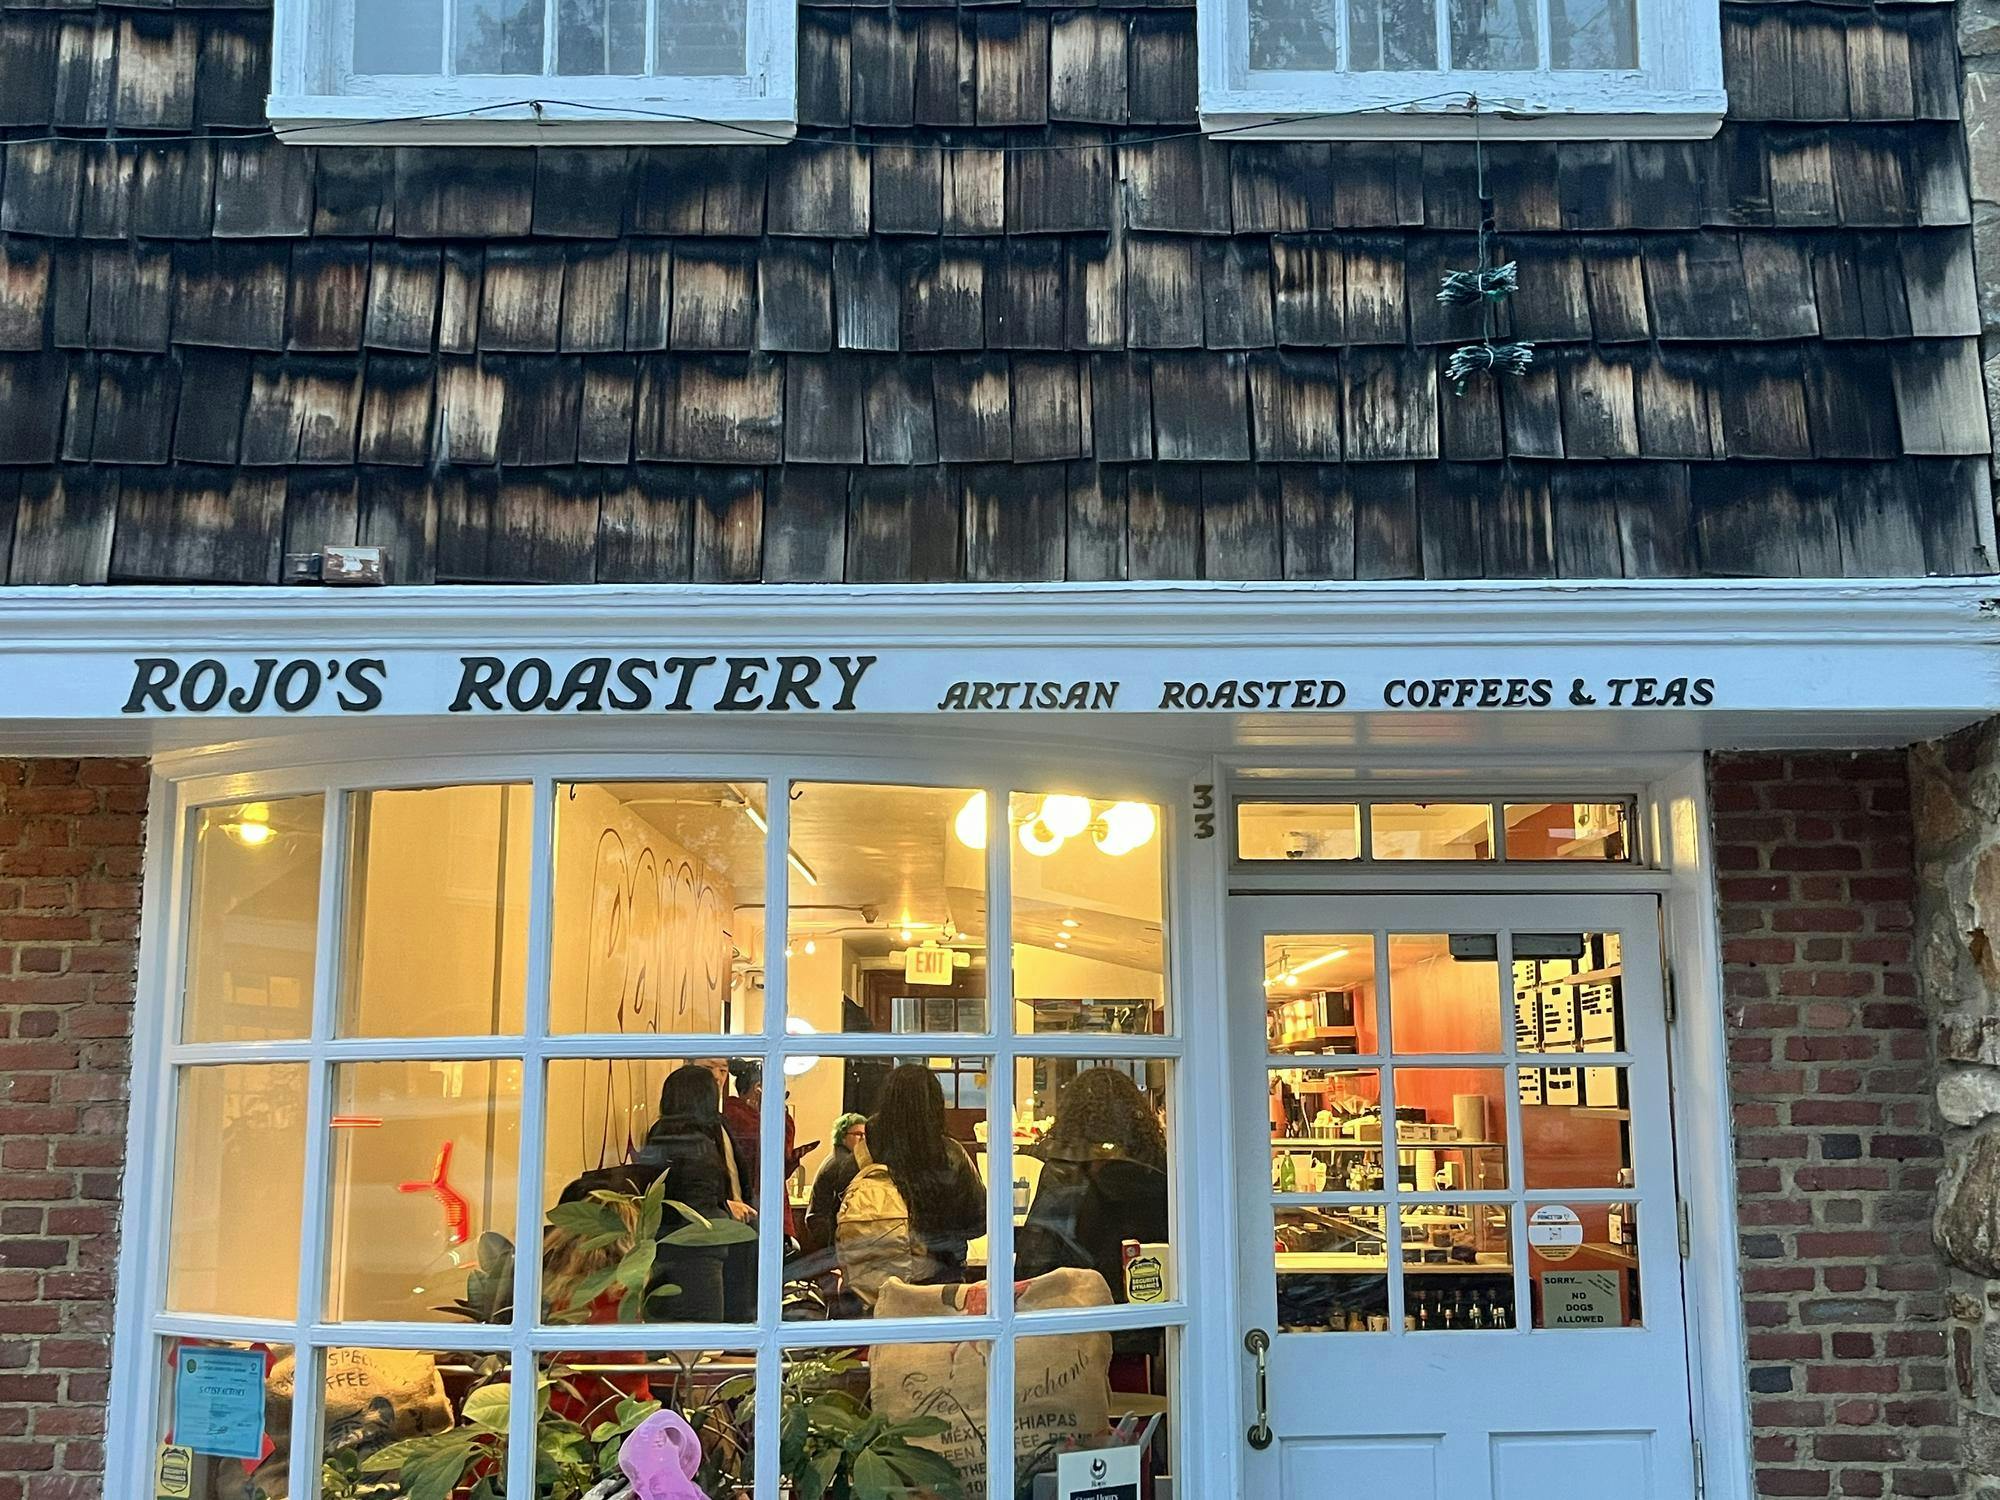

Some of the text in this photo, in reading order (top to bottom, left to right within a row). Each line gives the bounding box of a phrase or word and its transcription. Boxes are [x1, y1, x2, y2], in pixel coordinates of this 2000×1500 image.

[122, 655, 877, 713] ROJO'S ROASTERY
[937, 677, 1715, 711] ARTISAN ROASTED COFFEES & TEAS
[916, 951, 945, 973] EXIT
[1571, 1292, 1587, 1300] NO
[1566, 1303, 1594, 1312] DOGS
[1556, 1315, 1604, 1323] ALLOWED
